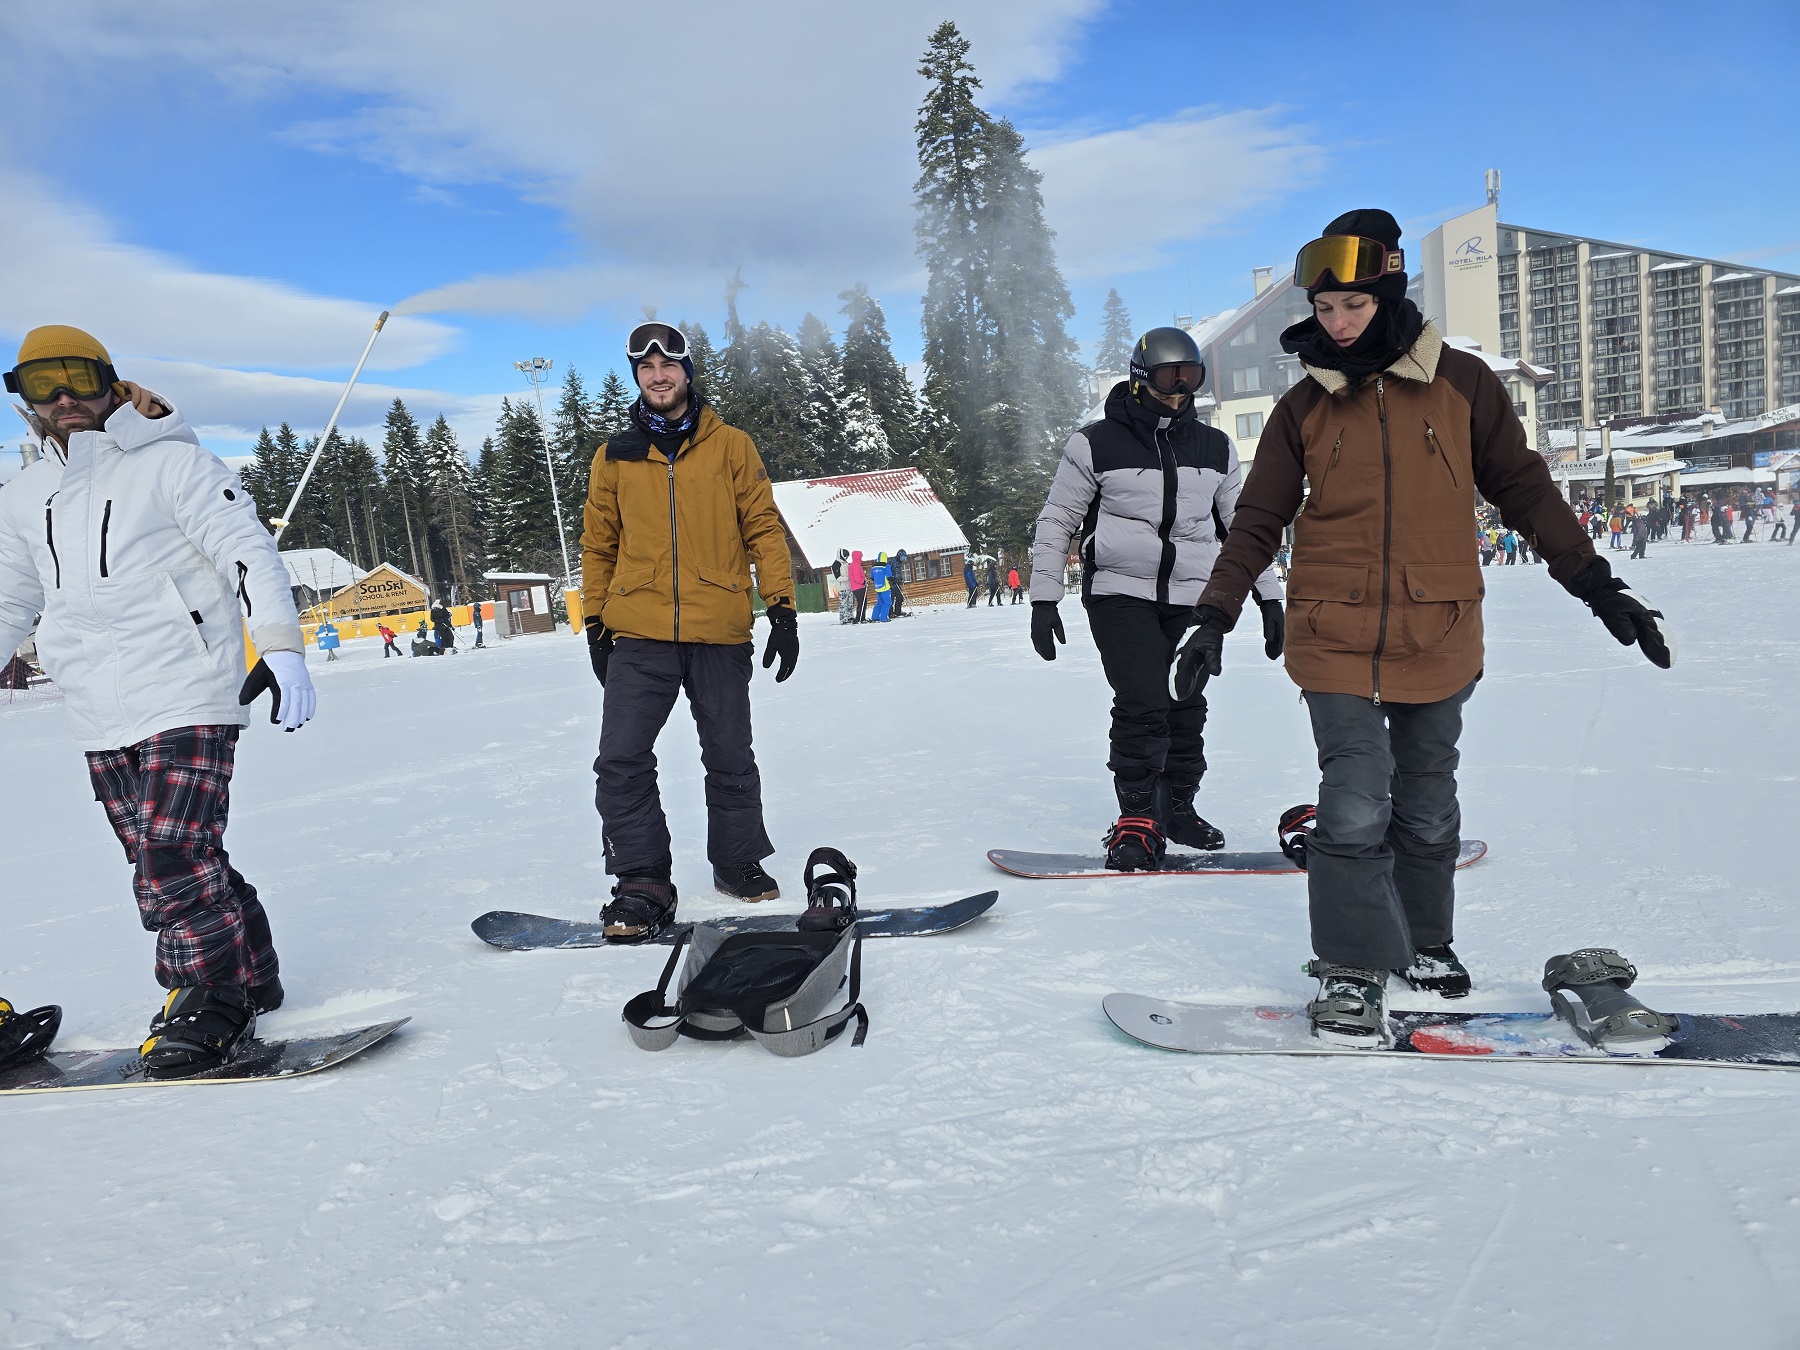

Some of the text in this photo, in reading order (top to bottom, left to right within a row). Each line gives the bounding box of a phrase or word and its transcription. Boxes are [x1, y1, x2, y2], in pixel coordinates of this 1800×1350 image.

[1131, 365, 1149, 378] SMITH
[1761, 408, 1789, 421] BLACK
[1771, 412, 1797, 424] TIGER
[1630, 456, 1654, 464] RECHARGE
[360, 579, 404, 595] SanSki
[359, 593, 385, 602] SCHOOL
